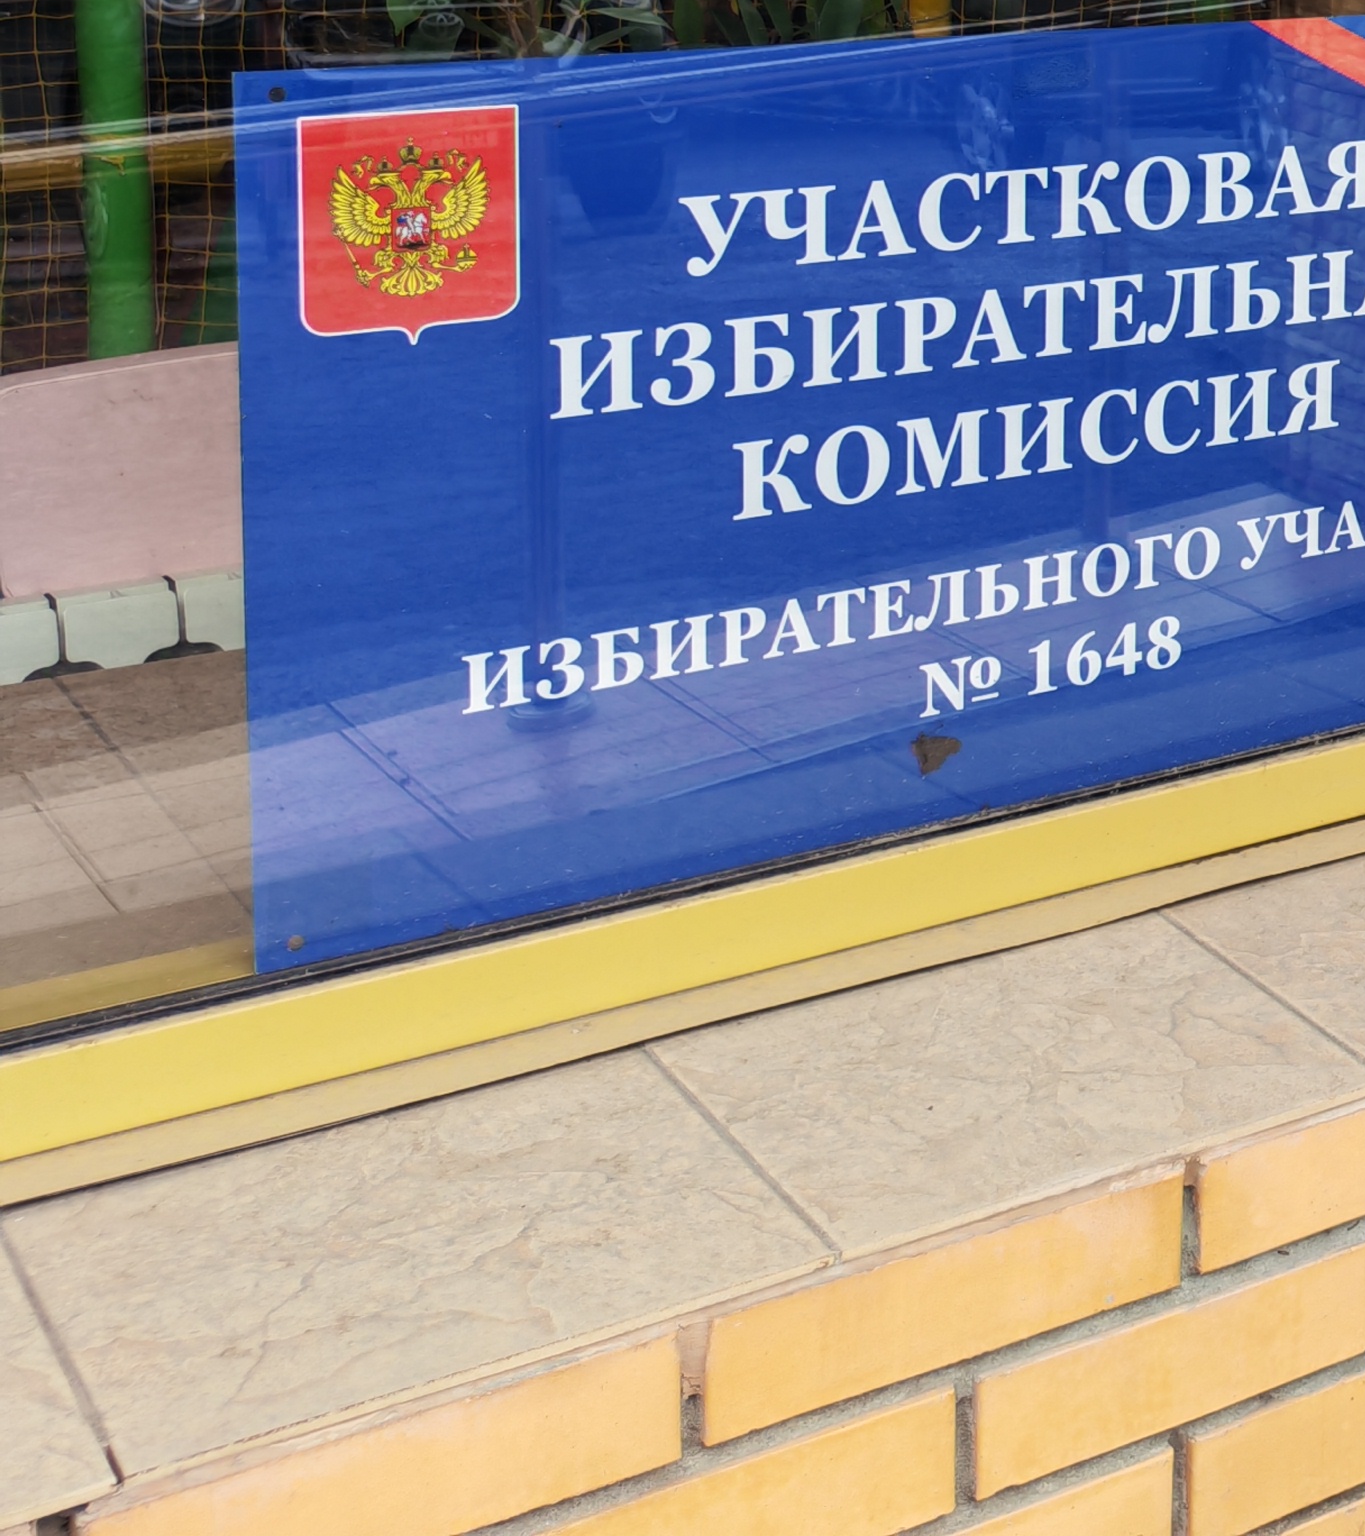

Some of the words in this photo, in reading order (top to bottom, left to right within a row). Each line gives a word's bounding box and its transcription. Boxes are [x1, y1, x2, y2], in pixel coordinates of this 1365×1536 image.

[732, 360, 1341, 521] КОМИССИЯ
[461, 527, 1221, 715] ИЗБИРАТЕЛЬНОГО
[919, 654, 1002, 718] №
[1027, 615, 1182, 697] 1648
